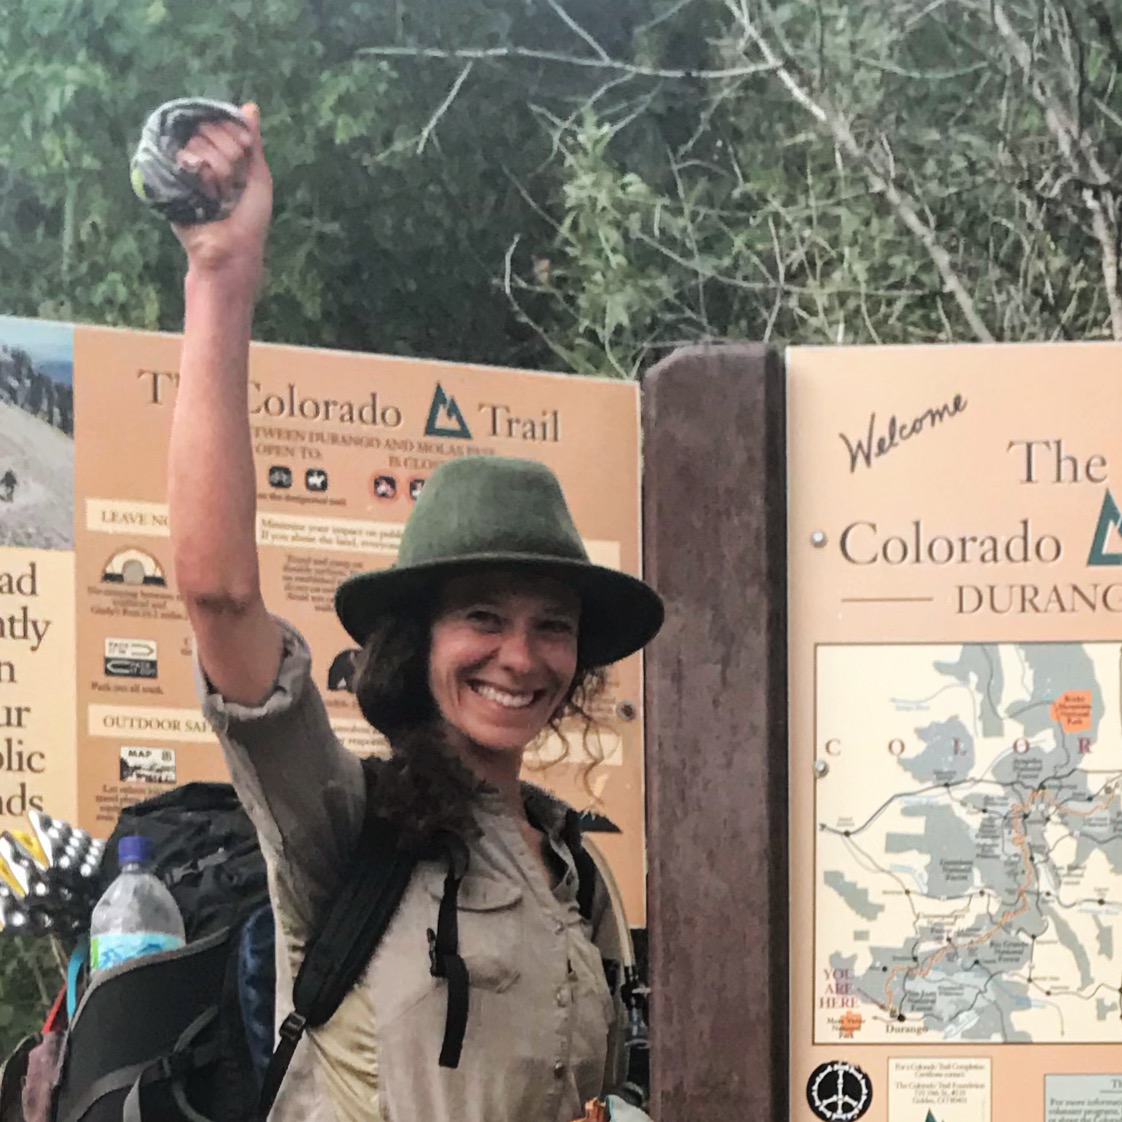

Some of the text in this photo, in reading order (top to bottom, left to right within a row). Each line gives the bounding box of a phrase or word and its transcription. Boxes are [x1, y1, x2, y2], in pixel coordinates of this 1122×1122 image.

[478, 402, 560, 443] Trail
[254, 427, 306, 442] TWEEN
[839, 393, 968, 474] Welcome
[1007, 438, 1109, 484] The
[102, 510, 145, 526] LEAVE
[838, 517, 1063, 567] Colorado
[0, 606, 51, 652] tly
[103, 713, 181, 732] OUTDOOR
[0, 738, 46, 774] lic
[128, 750, 152, 759] MAP
[0, 782, 44, 818] ds
[824, 968, 851, 980] YOU
[825, 983, 853, 995] ARE
[819, 997, 860, 1009] HERE
[886, 1024, 929, 1035] Durango
